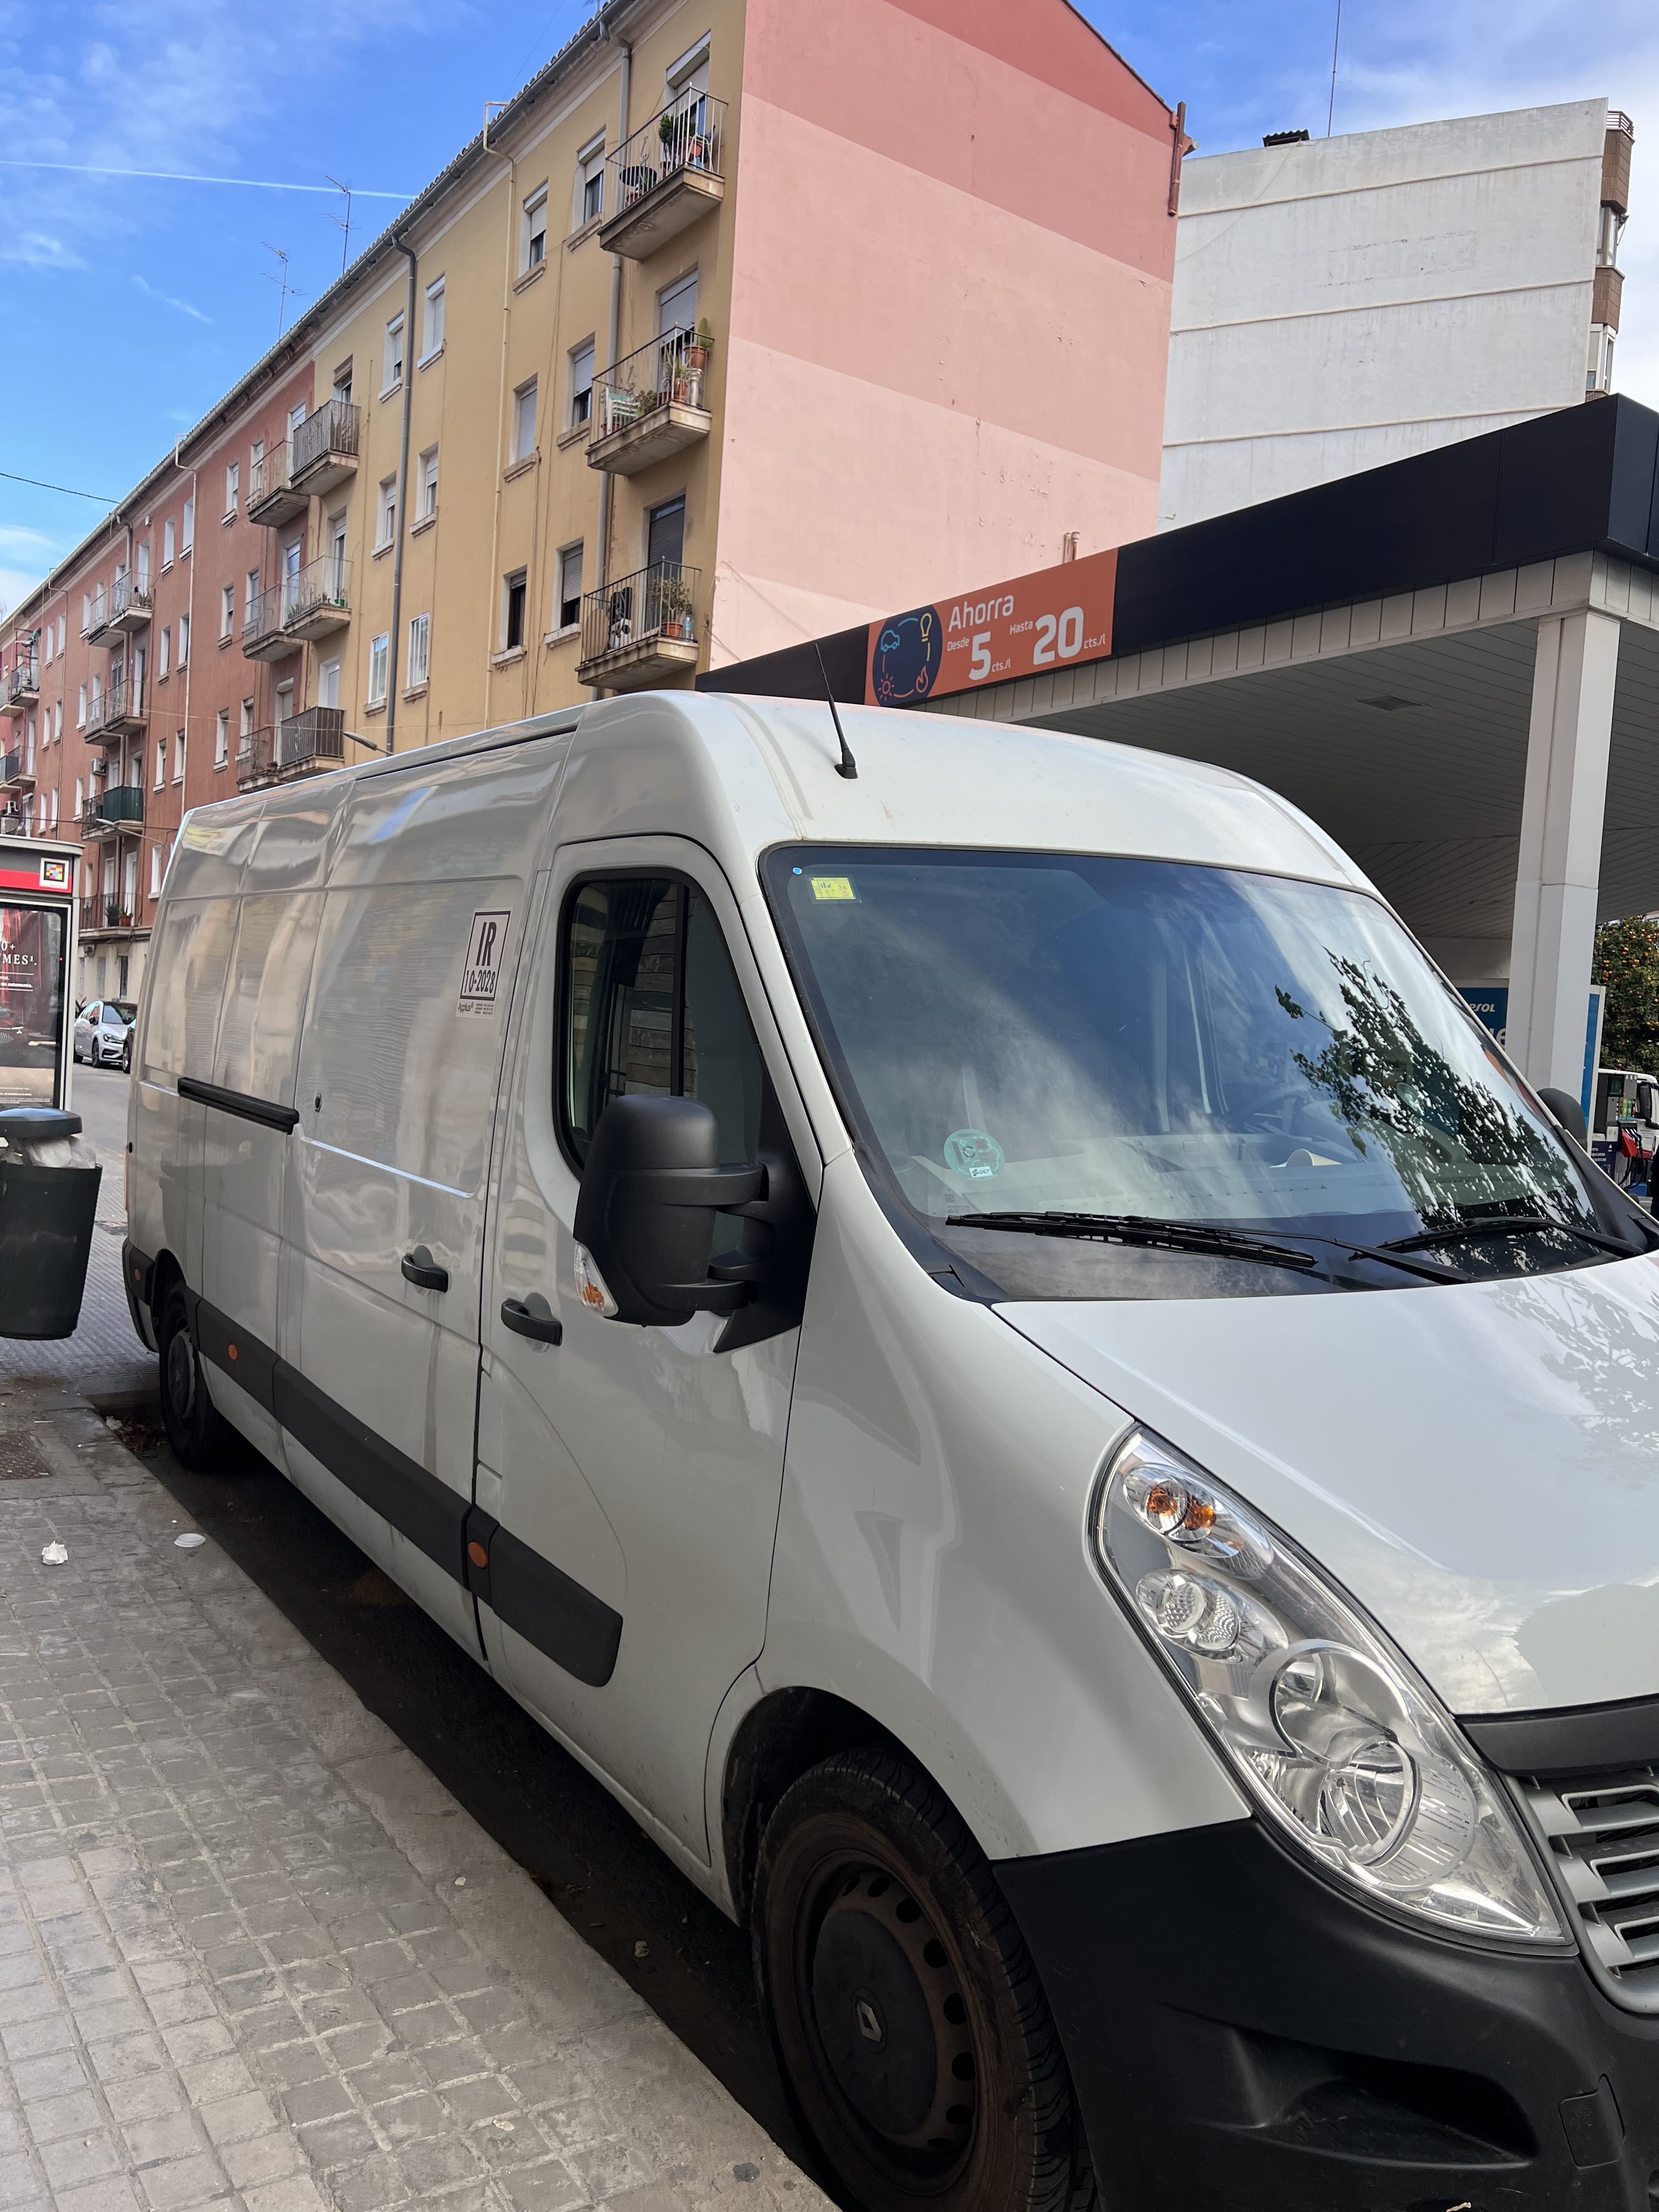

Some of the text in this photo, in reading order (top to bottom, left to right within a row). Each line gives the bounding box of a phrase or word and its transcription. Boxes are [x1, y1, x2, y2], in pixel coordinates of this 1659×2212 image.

[947, 595, 1014, 632] Ahorra
[1009, 620, 1033, 635] Hasta
[1033, 606, 1085, 665] 20
[947, 636, 970, 651] Desde
[968, 631, 991, 680] 5
[1, 941, 15, 951] 0+
[476, 922, 496, 966] IR
[464, 969, 496, 994] 10-2028
[1470, 1003, 1496, 1012] PSOL
